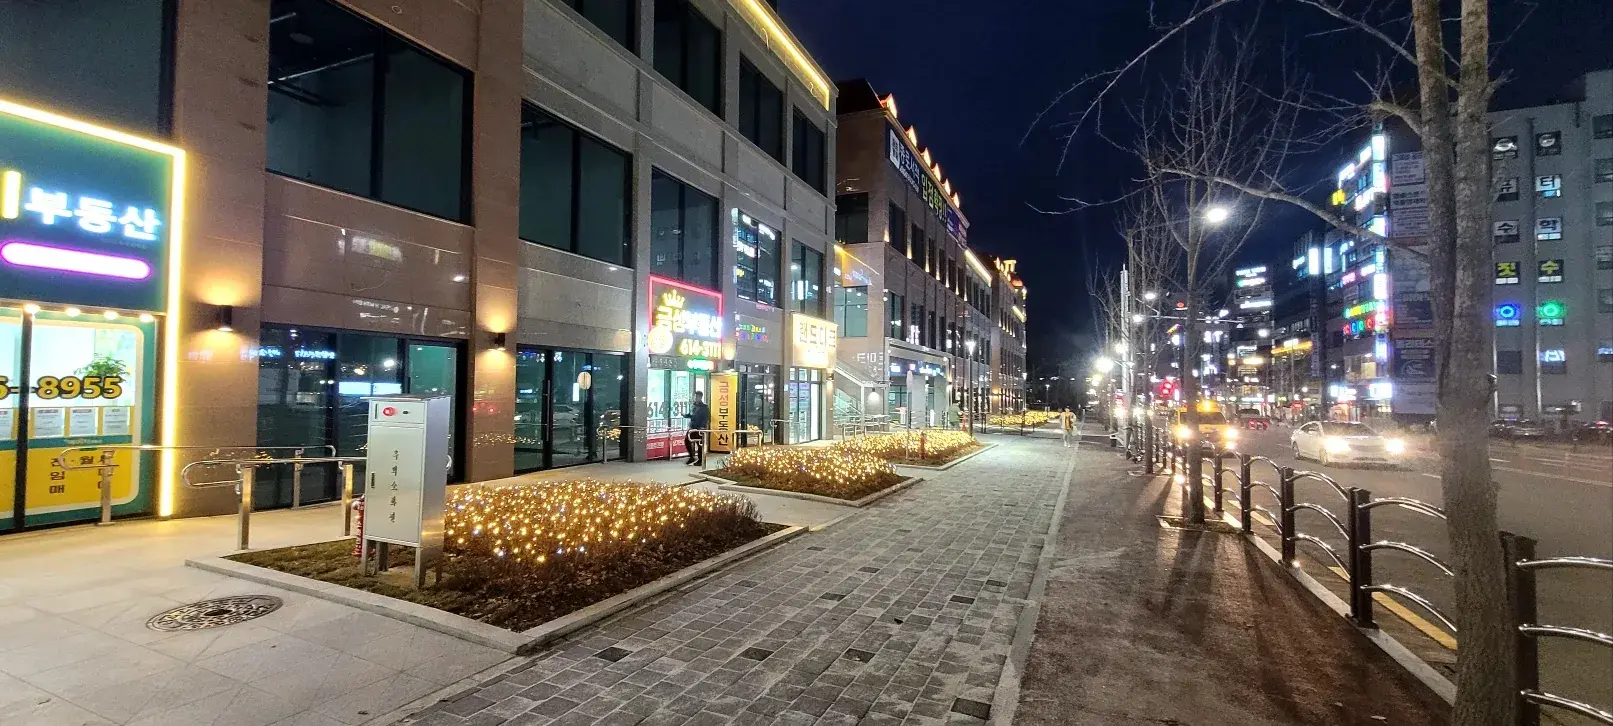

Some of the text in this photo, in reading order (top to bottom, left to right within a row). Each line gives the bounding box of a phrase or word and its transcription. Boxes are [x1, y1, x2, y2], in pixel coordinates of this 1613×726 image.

[24, 186, 162, 241] 부동산
[656, 306, 723, 338] 금성부동산
[679, 338, 722, 359] 614-3111
[718, 381, 730, 447] 금성부동산
